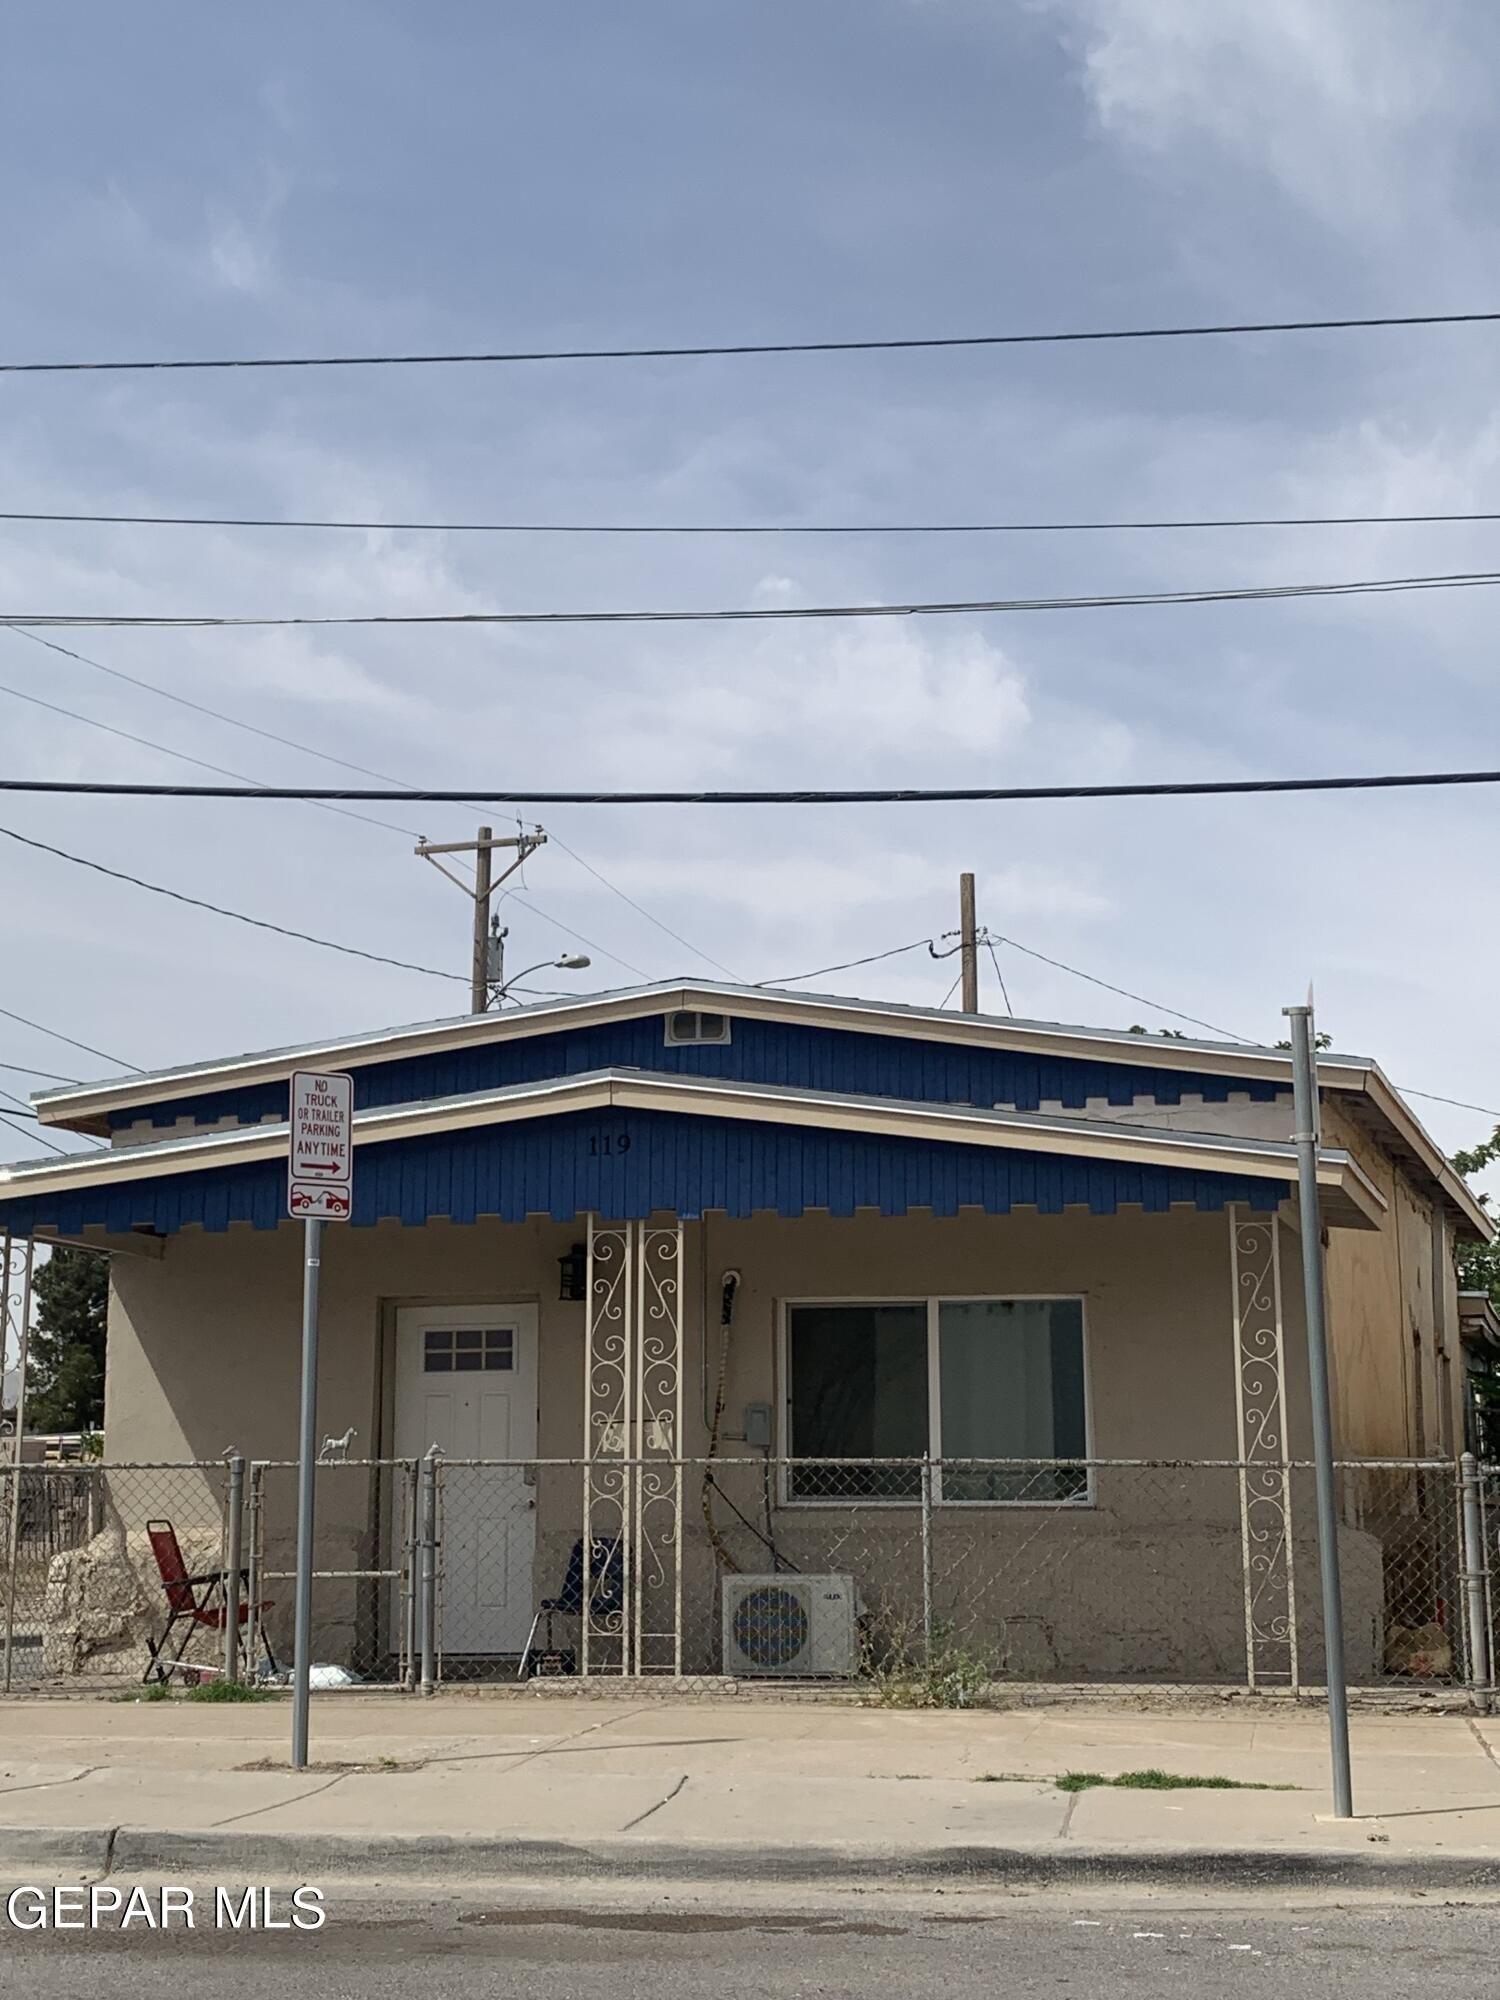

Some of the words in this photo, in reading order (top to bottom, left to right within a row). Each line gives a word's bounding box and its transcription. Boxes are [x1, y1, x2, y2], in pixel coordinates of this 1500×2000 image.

[314, 1079, 328, 1093] NO
[304, 1093, 338, 1108] TRUCK
[297, 1107, 309, 1120] OR
[311, 1108, 345, 1123] TRAILER
[301, 1123, 341, 1138] PARKING
[296, 1140, 346, 1158] ANYTIME
[590, 1134, 631, 1156] 119
